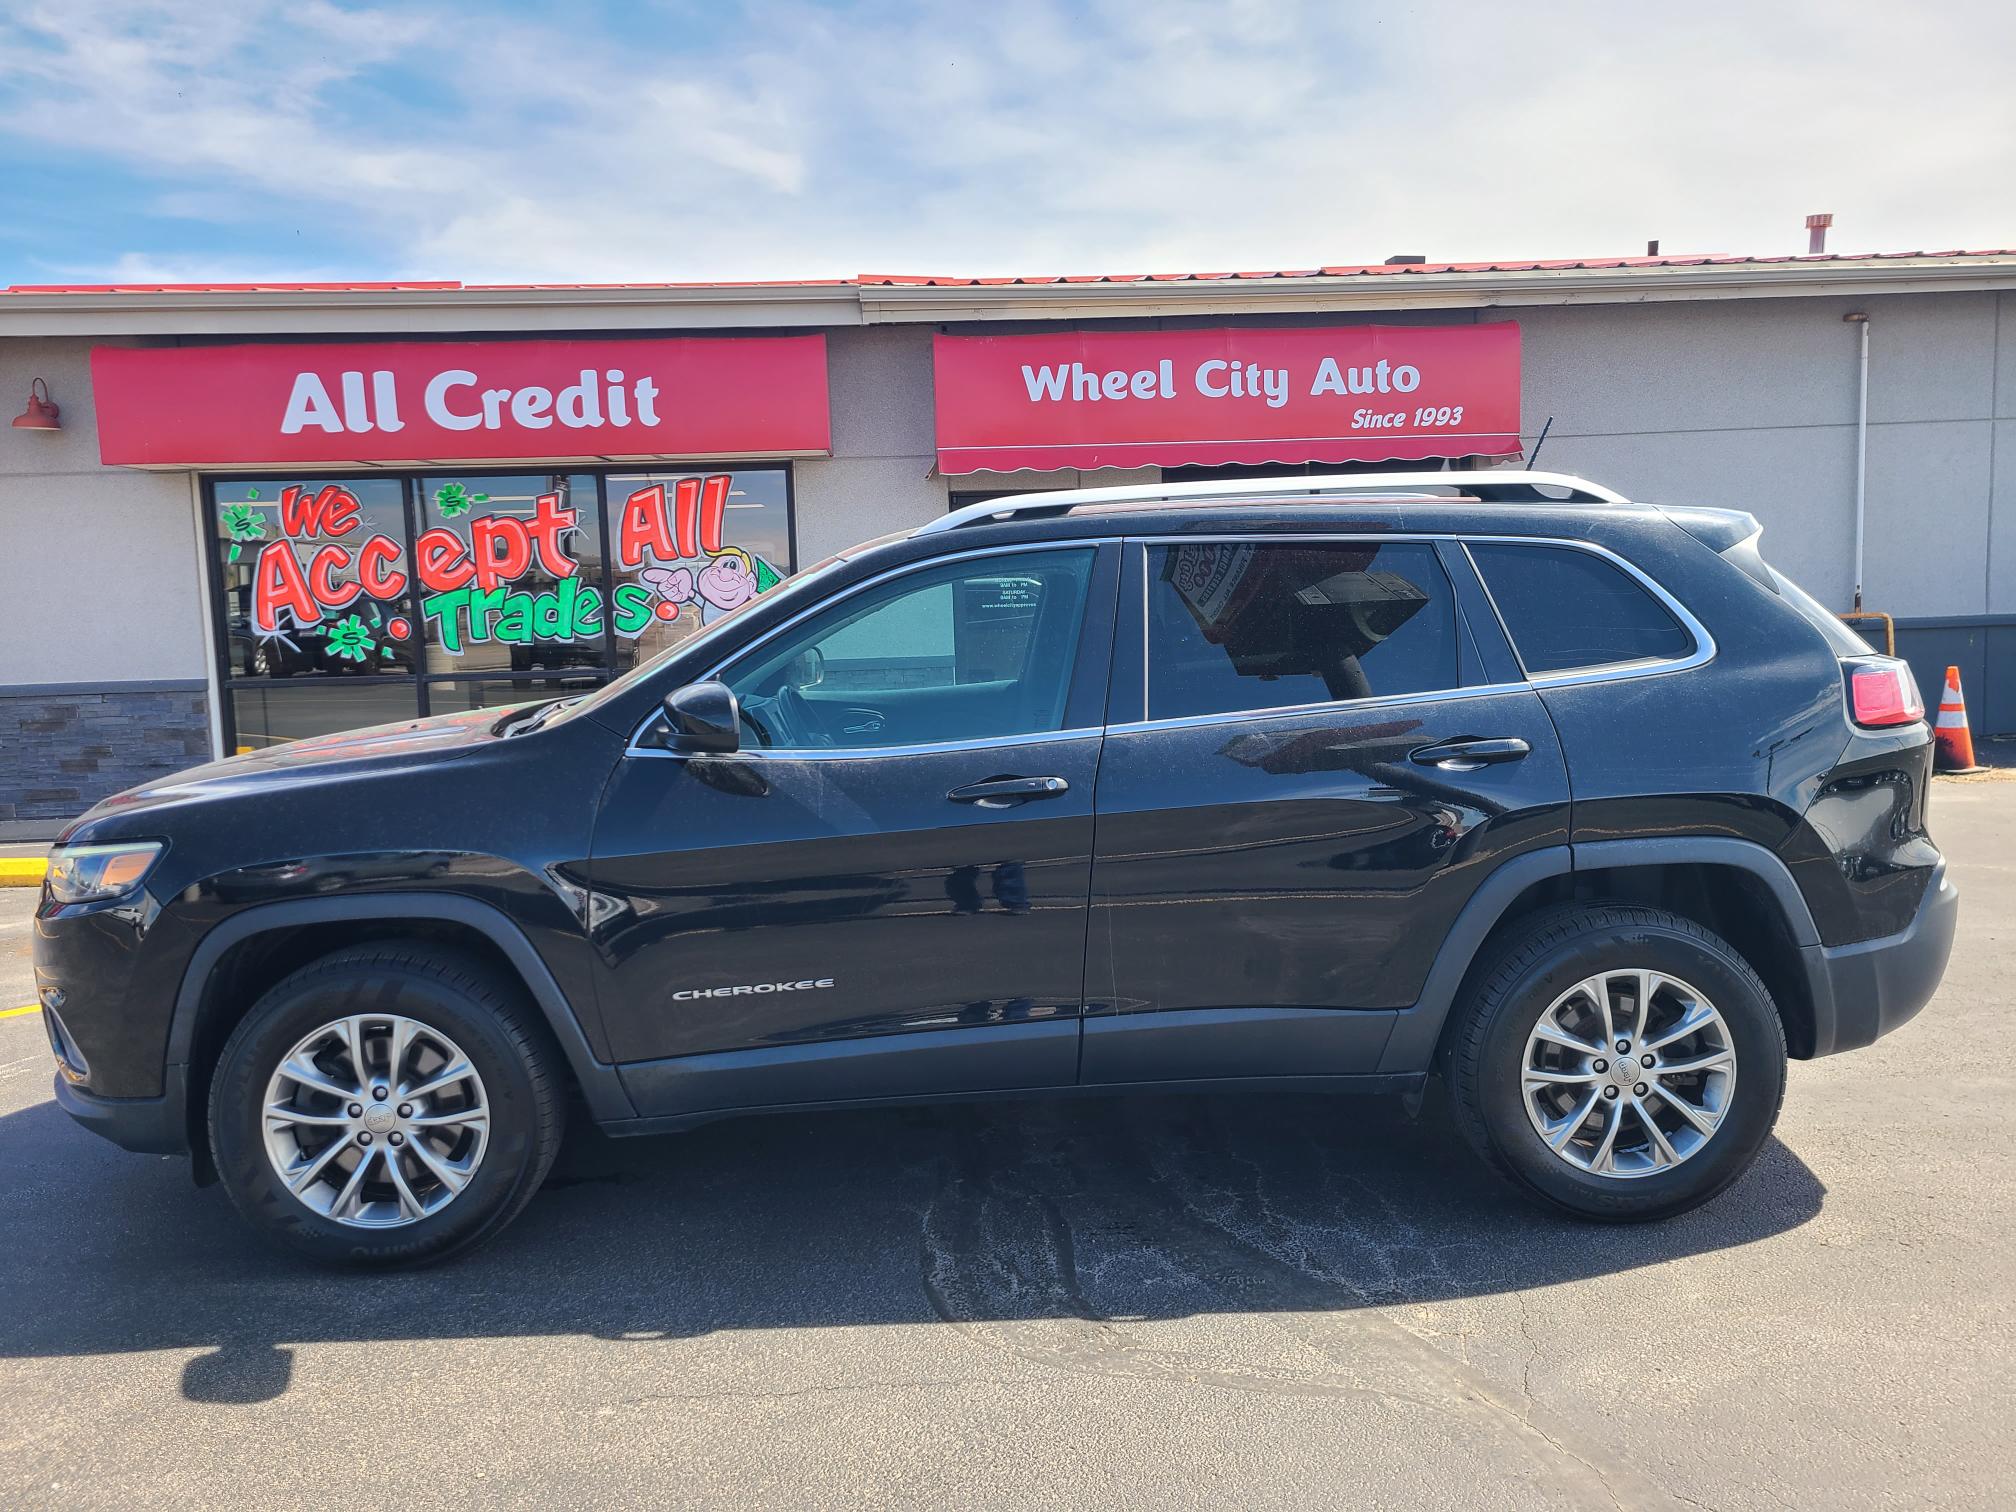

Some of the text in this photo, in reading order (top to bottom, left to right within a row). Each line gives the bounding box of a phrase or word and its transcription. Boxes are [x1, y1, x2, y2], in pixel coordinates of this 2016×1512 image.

[280, 369, 661, 434] All Credit
[1021, 357, 1422, 408] Wheel City Auto
[1351, 406, 1464, 429] Since 1993
[281, 484, 362, 538] We
[256, 474, 732, 632] Accept All
[423, 576, 653, 652] Trades
[672, 978, 835, 1001] CHEROKEE
[1618, 1062, 1633, 1084] Jeep
